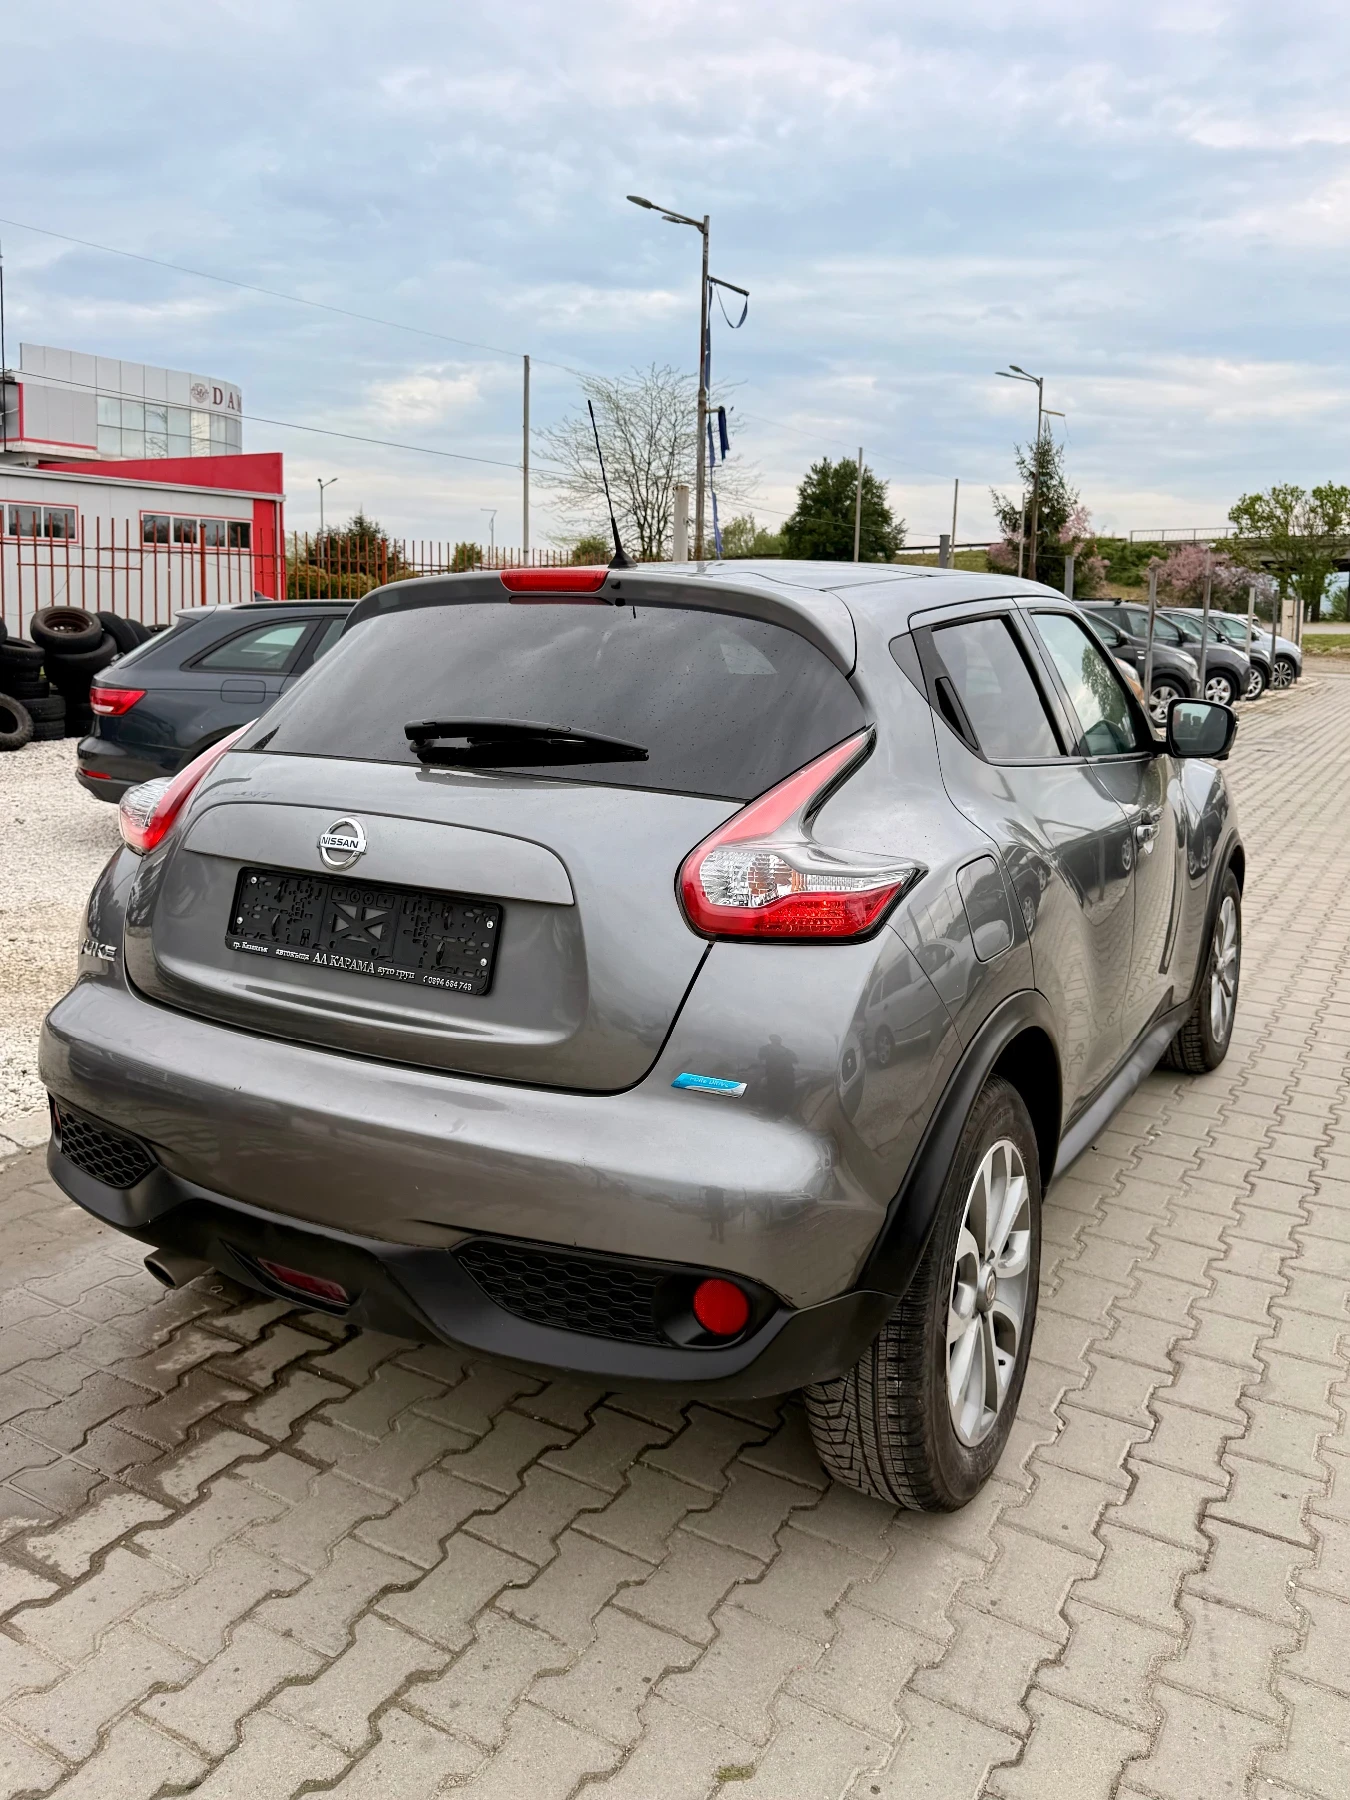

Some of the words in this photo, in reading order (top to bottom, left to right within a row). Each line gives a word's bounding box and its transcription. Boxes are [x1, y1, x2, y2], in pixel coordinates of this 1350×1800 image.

[321, 836, 359, 849] NISSAN
[312, 952, 328, 965] АЛ
[329, 954, 375, 974] КАРАМА
[396, 969, 415, 980] груп
